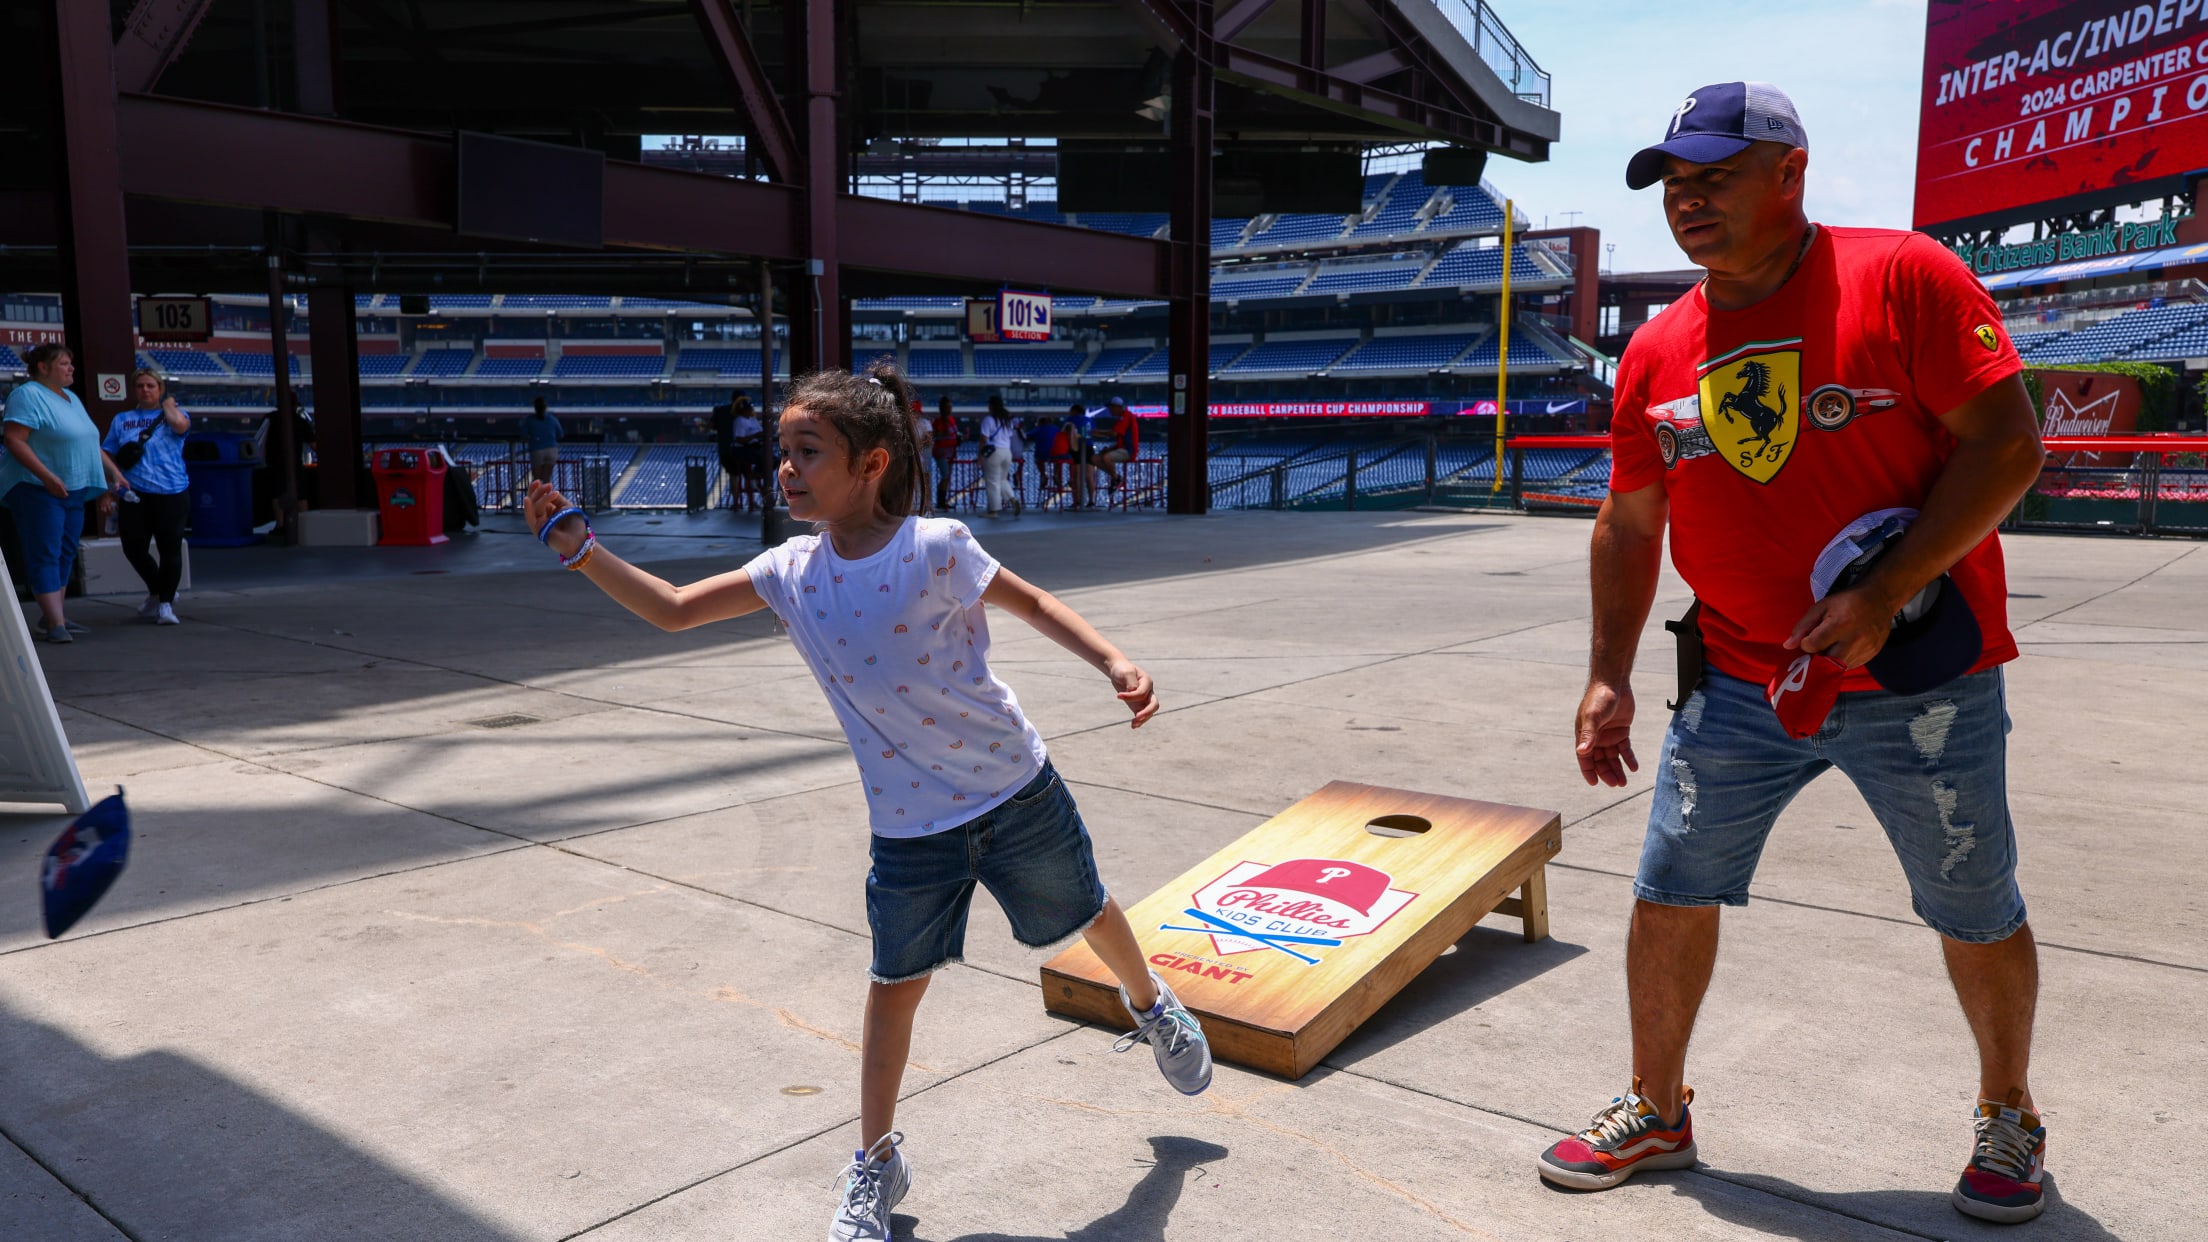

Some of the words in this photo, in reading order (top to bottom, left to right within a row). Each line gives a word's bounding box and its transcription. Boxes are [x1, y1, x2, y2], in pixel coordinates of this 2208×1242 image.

[2019, 84, 2066, 116] 2024
[2069, 46, 2192, 100] CARPENTER
[1672, 97, 1697, 134] P
[1976, 239, 2057, 274] Citizens
[2059, 221, 2118, 261] Bank
[2120, 212, 2179, 253] Park
[155, 303, 192, 329] 103
[1008, 298, 1032, 328] 101
[9, 330, 33, 343] THE
[1011, 331, 1041, 340] SECTION
[1221, 404, 1266, 415] BASEBALL
[1269, 404, 1323, 414] CARPENTER
[1326, 404, 1345, 413] CUP
[1348, 403, 1424, 414] CHAMPIONSHIP
[2042, 404, 2110, 437] Budweiser
[1740, 451, 1754, 468] S
[1766, 441, 1790, 463] F
[1771, 654, 1811, 711] P
[1315, 867, 1352, 884] P
[1215, 908, 1262, 926] KIDS
[1265, 920, 1329, 936] CLUB
[1216, 889, 1351, 929] Phillies
[1149, 953, 1254, 985] GIANT
[1174, 951, 1233, 968] PRESENTED
